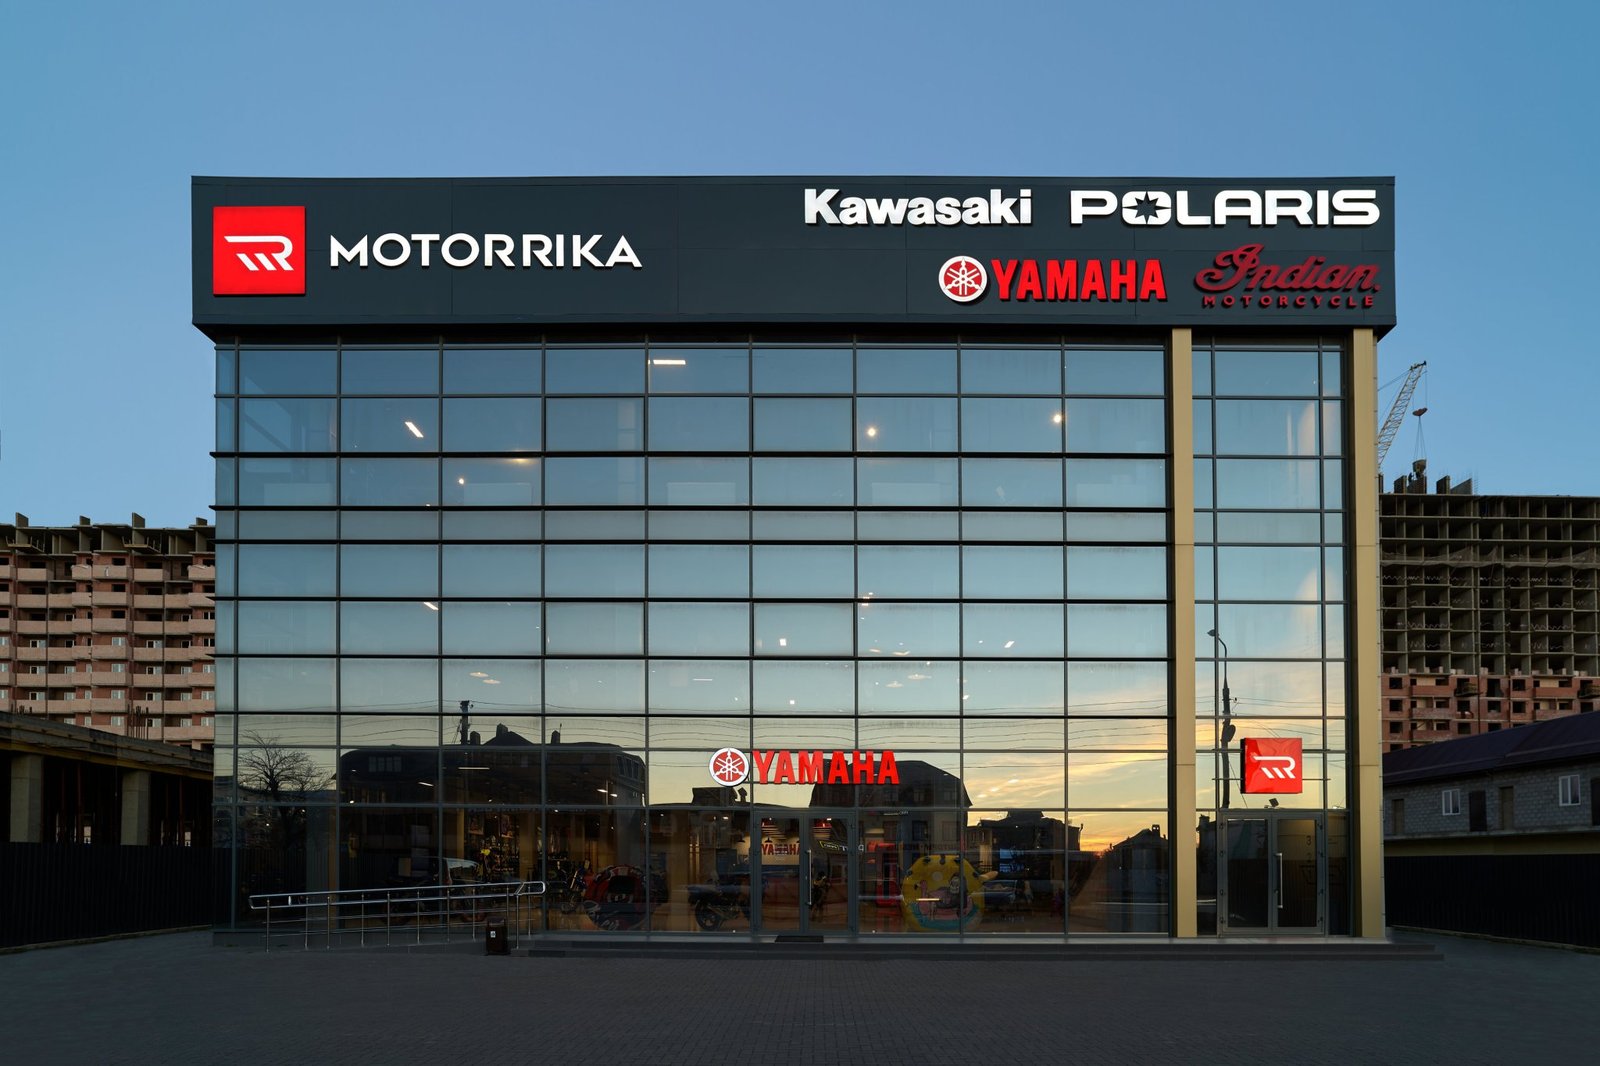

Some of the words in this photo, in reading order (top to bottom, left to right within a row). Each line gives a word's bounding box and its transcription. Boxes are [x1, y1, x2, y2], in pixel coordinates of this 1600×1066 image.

[804, 189, 1032, 226] Kawasaki
[1070, 190, 1380, 226] POLARIS
[330, 233, 643, 268] MOTORRIKA
[992, 260, 1167, 301] YAMAHA
[1203, 295, 1374, 307] MOTORCYCLE
[753, 751, 899, 785] YAMAHA
[761, 843, 800, 855] YAH
